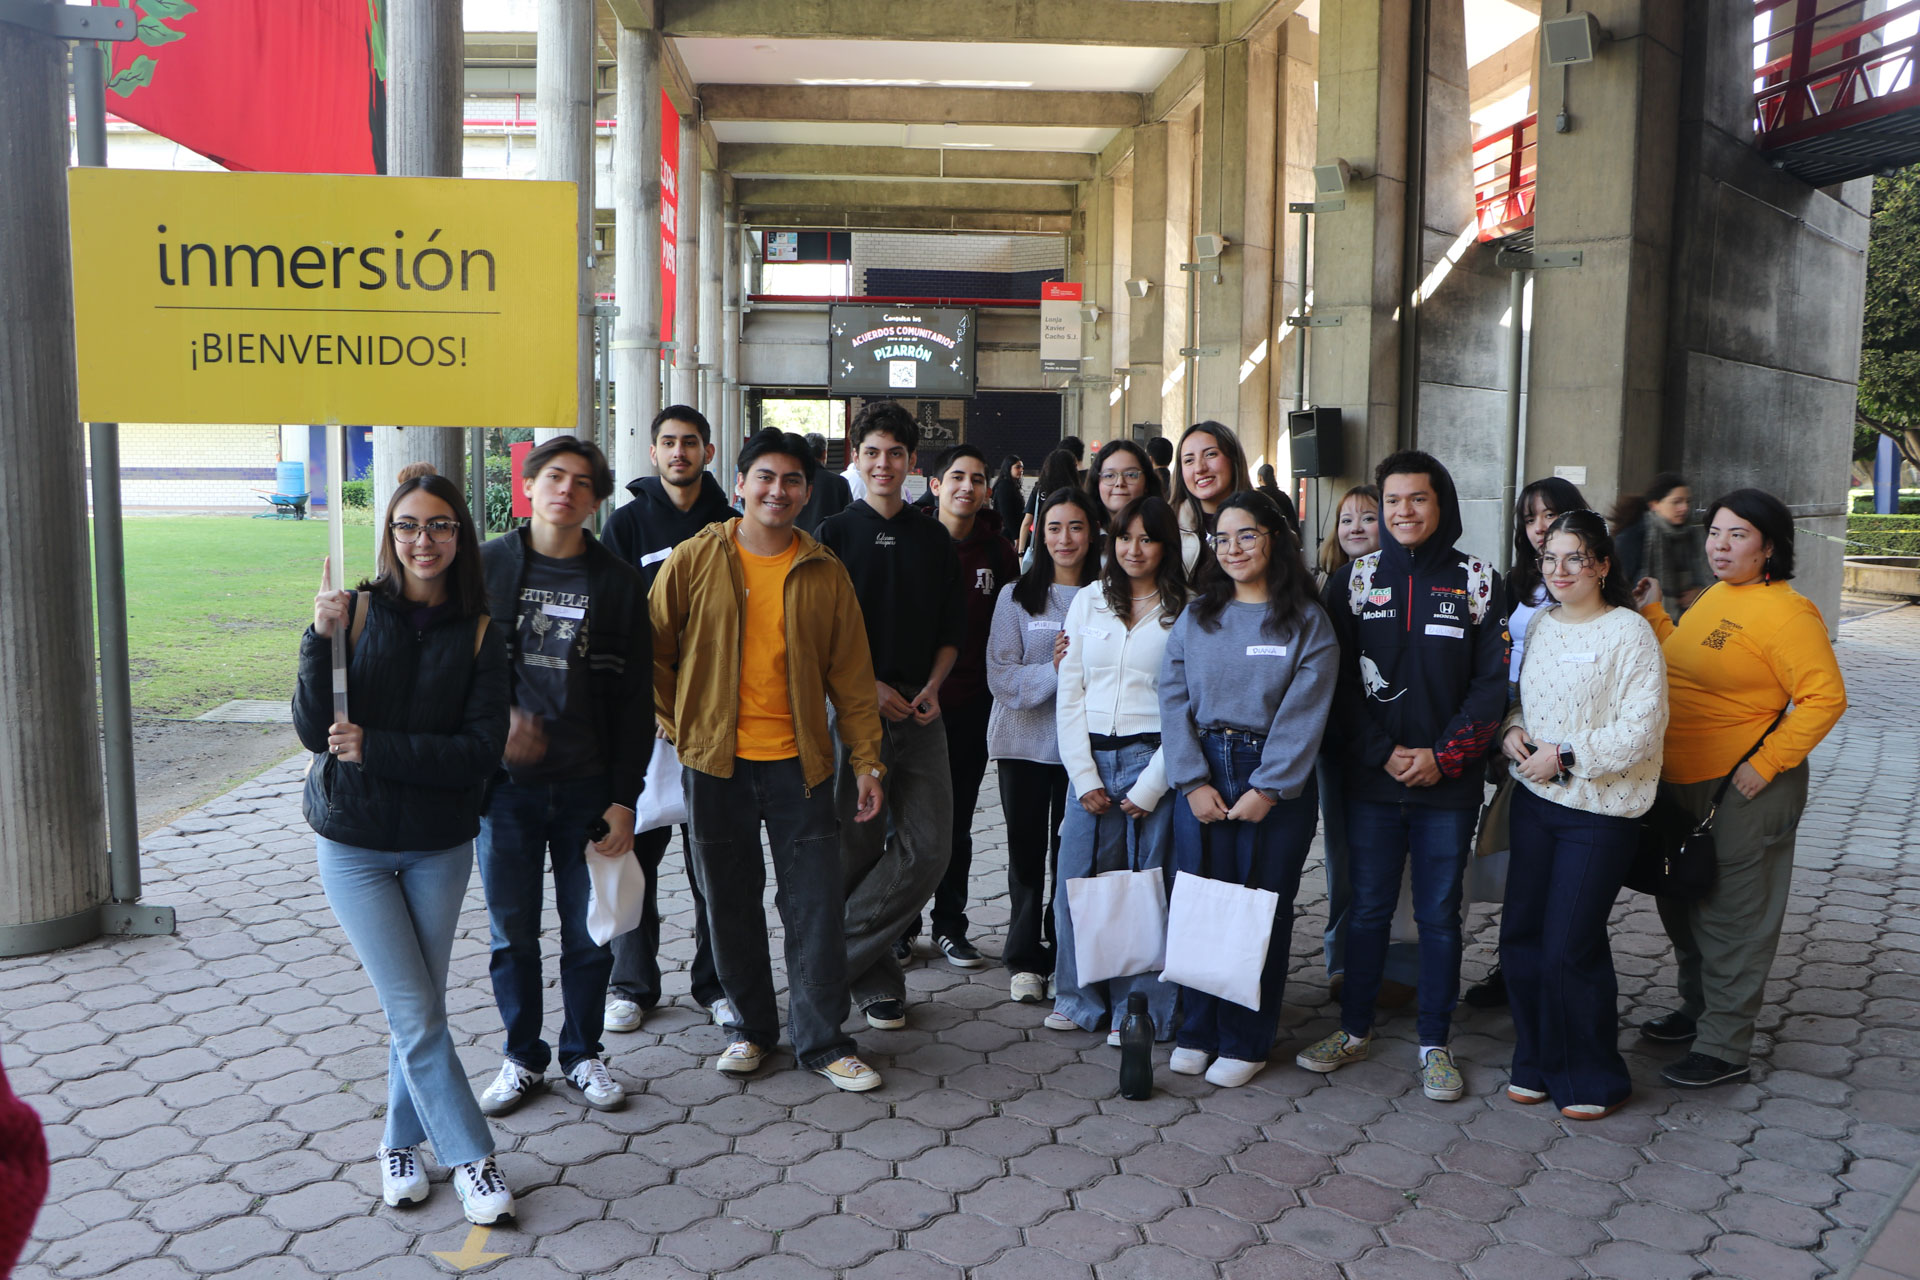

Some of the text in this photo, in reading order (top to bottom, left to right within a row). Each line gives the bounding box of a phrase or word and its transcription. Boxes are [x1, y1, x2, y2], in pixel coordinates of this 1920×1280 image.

[157, 224, 496, 292] inmersión
[1045, 316, 1062, 324] Lonja
[852, 326, 956, 349] ACUERDOS COMUNITARIOS
[191, 333, 467, 371] ¡BIENVENIDOS!
[873, 344, 933, 362] PIZARRÓN
[1370, 588, 1391, 596] TAG
[1363, 609, 1387, 620] Mobil
[1252, 646, 1277, 655] DIANA
